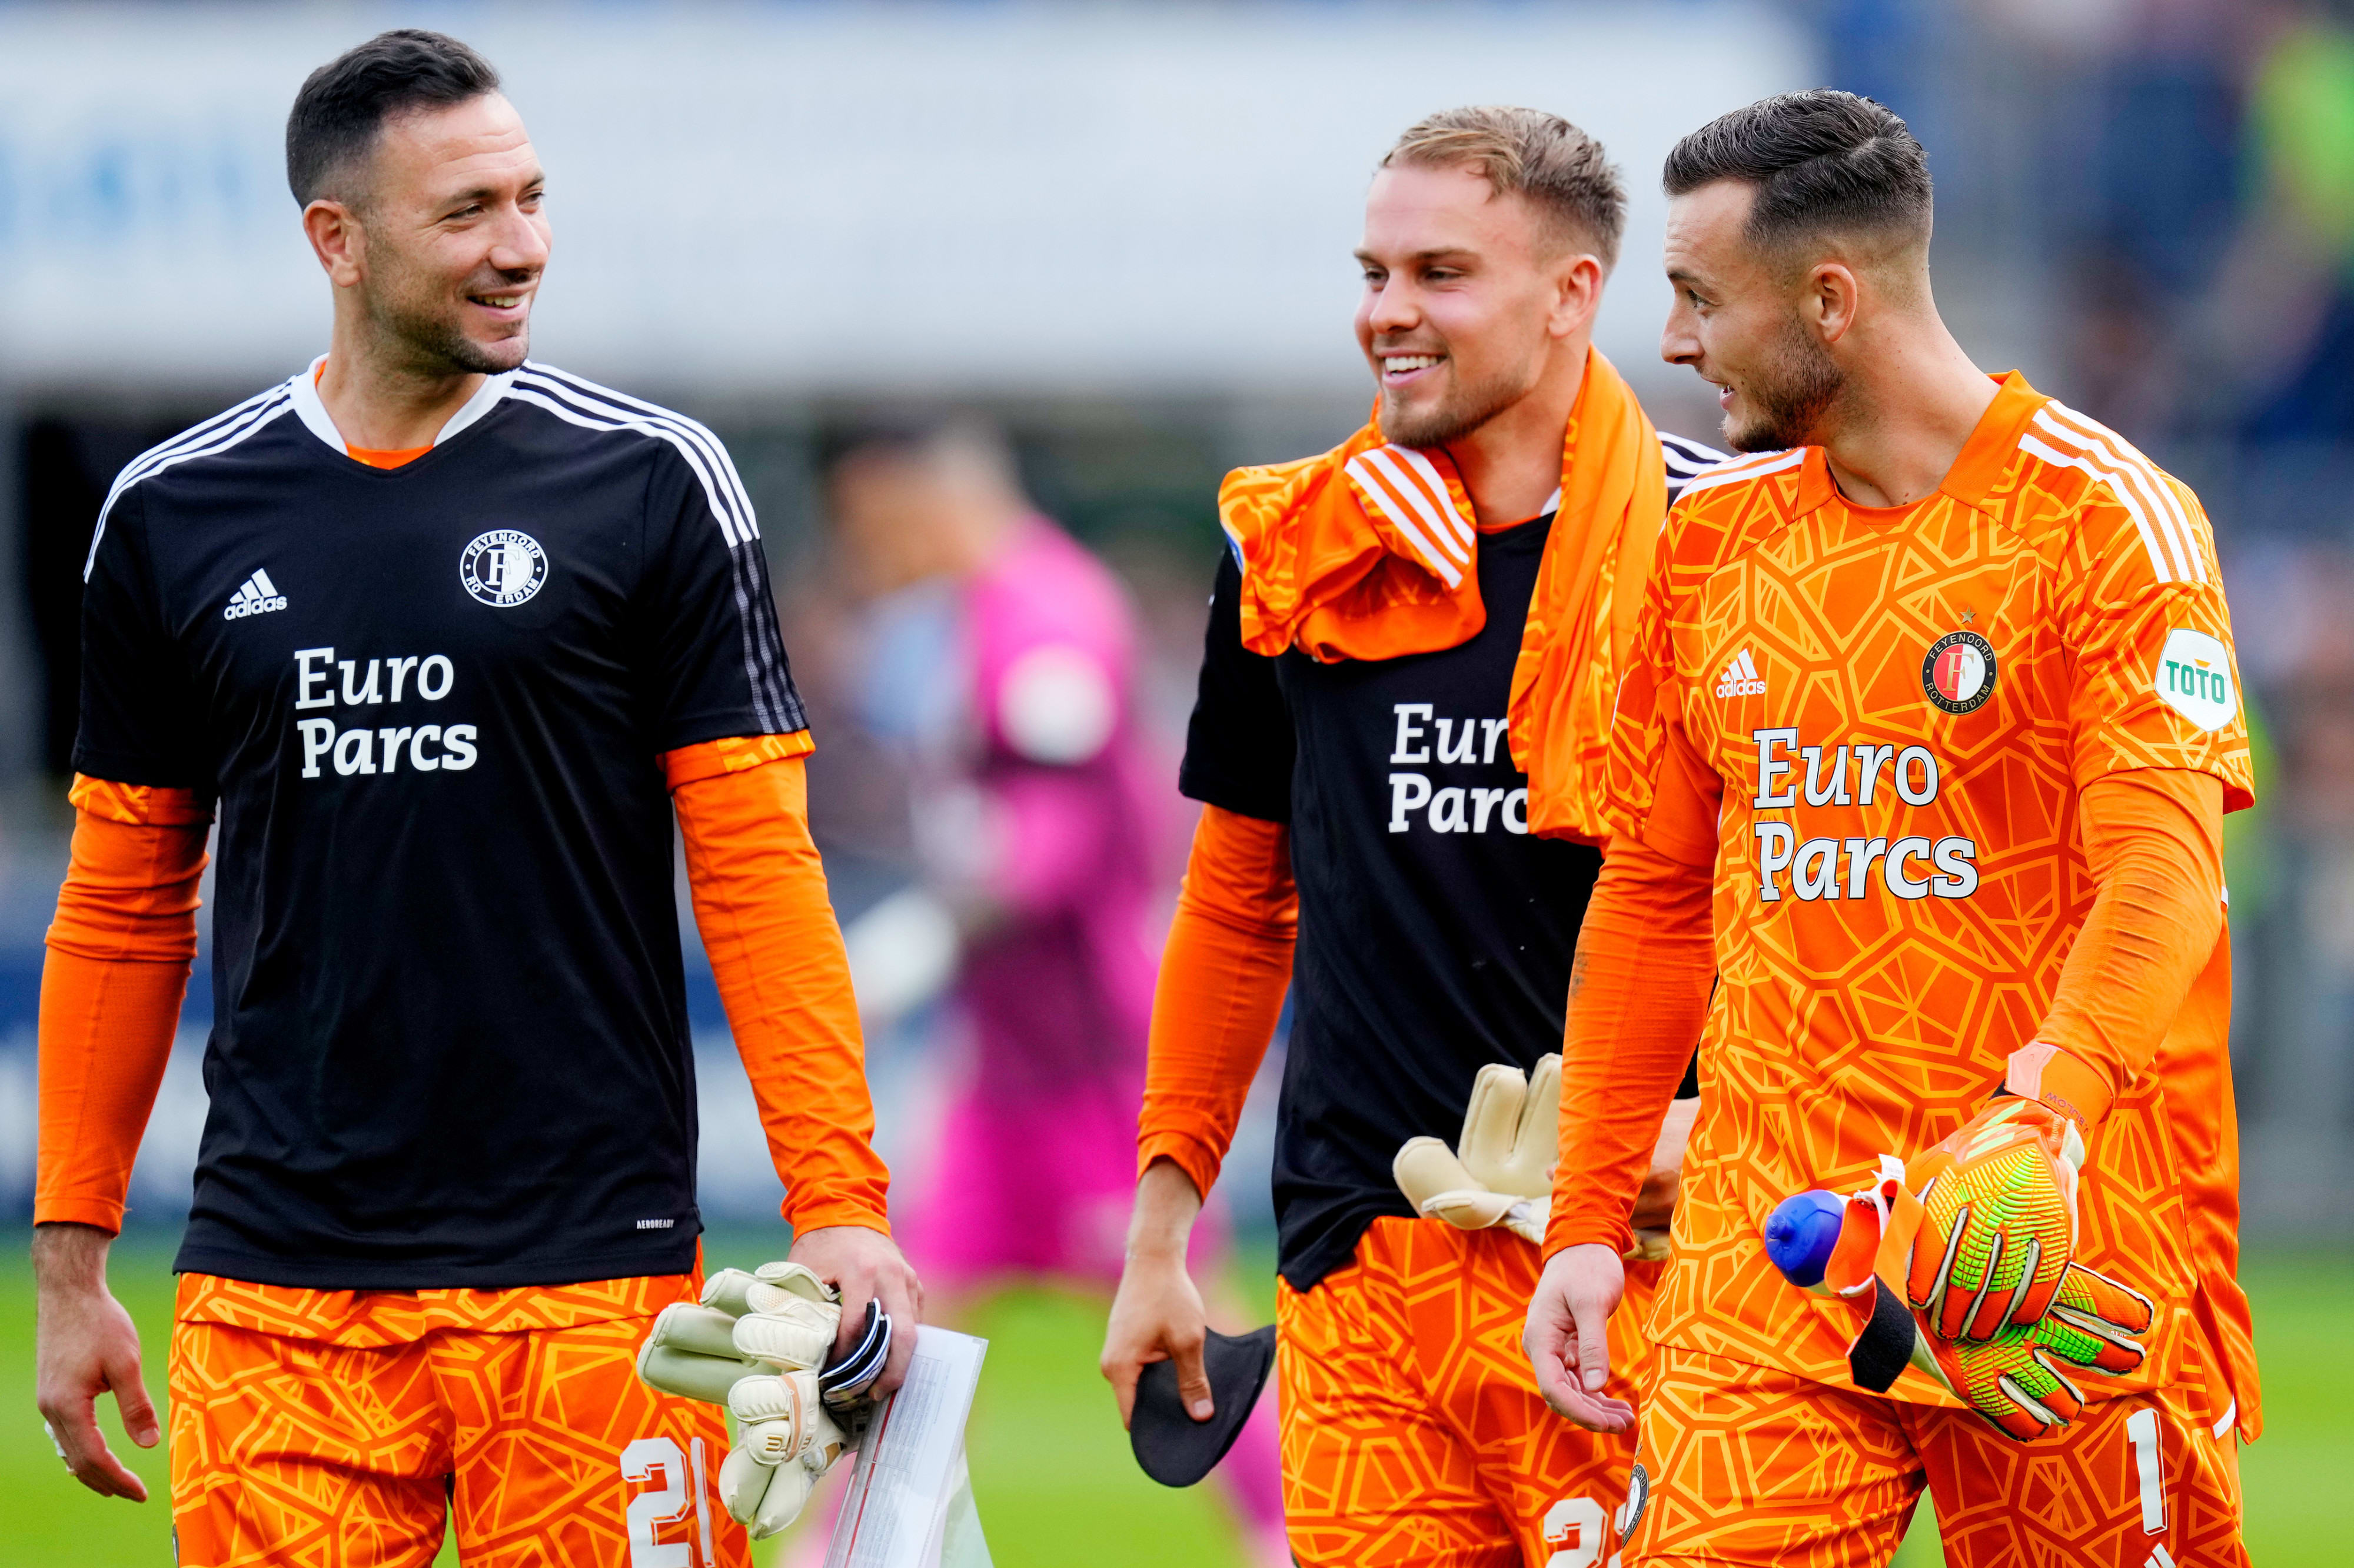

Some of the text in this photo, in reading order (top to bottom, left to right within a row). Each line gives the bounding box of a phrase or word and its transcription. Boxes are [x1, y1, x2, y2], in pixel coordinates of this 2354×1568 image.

[467, 533, 541, 559] FEYENOORD
[224, 595, 288, 621] adidas
[1929, 634, 1993, 661] FEYENOORD
[294, 647, 454, 710] Euro
[1716, 678, 1766, 698] adidas
[1925, 682, 1990, 711] ROTTERDAM
[2166, 660, 2226, 704] TOTO
[297, 717, 478, 778] Parcs
[1390, 703, 1510, 764] Eur
[1753, 727, 1940, 810] Euro
[1388, 773, 1528, 834] Parc
[1754, 821, 1979, 902] Parcs
[2044, 1091, 2085, 1126] BIJLOW
[636, 1219, 674, 1230] AEROREADY
[2126, 1407, 2167, 1536] 1
[619, 1437, 714, 1568] 21
